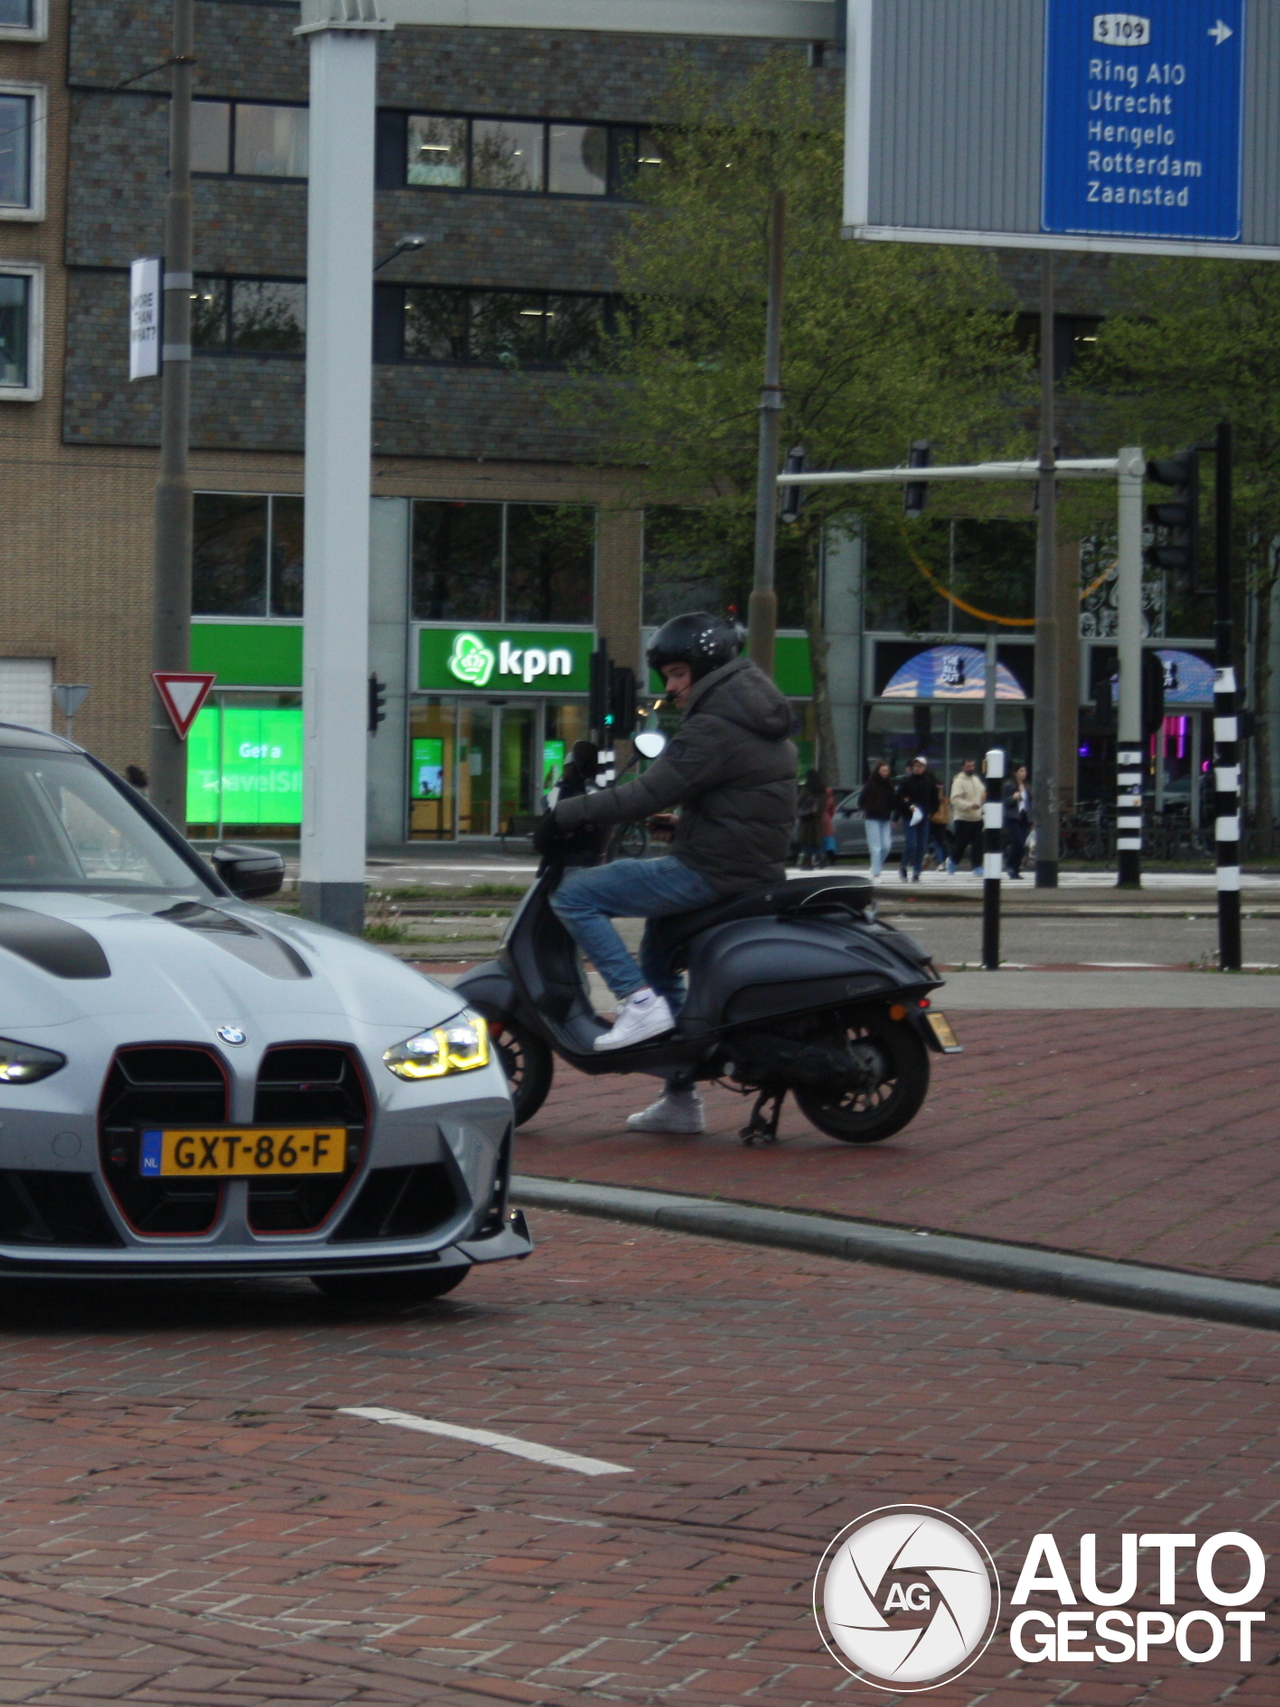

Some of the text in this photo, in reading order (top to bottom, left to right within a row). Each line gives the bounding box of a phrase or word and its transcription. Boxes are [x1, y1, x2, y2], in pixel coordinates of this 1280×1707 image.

[1098, 20, 1144, 39] S 109
[1089, 59, 1186, 89] Ring A10
[1088, 90, 1172, 115] Utrecht
[1088, 120, 1176, 149] Hengelo
[1088, 151, 1202, 177] Rotterdam
[1087, 181, 1189, 207] Zaanstad
[499, 641, 570, 683] kpn
[239, 743, 282, 758] Get a
[144, 1134, 331, 1169] NL GXT-86-F
